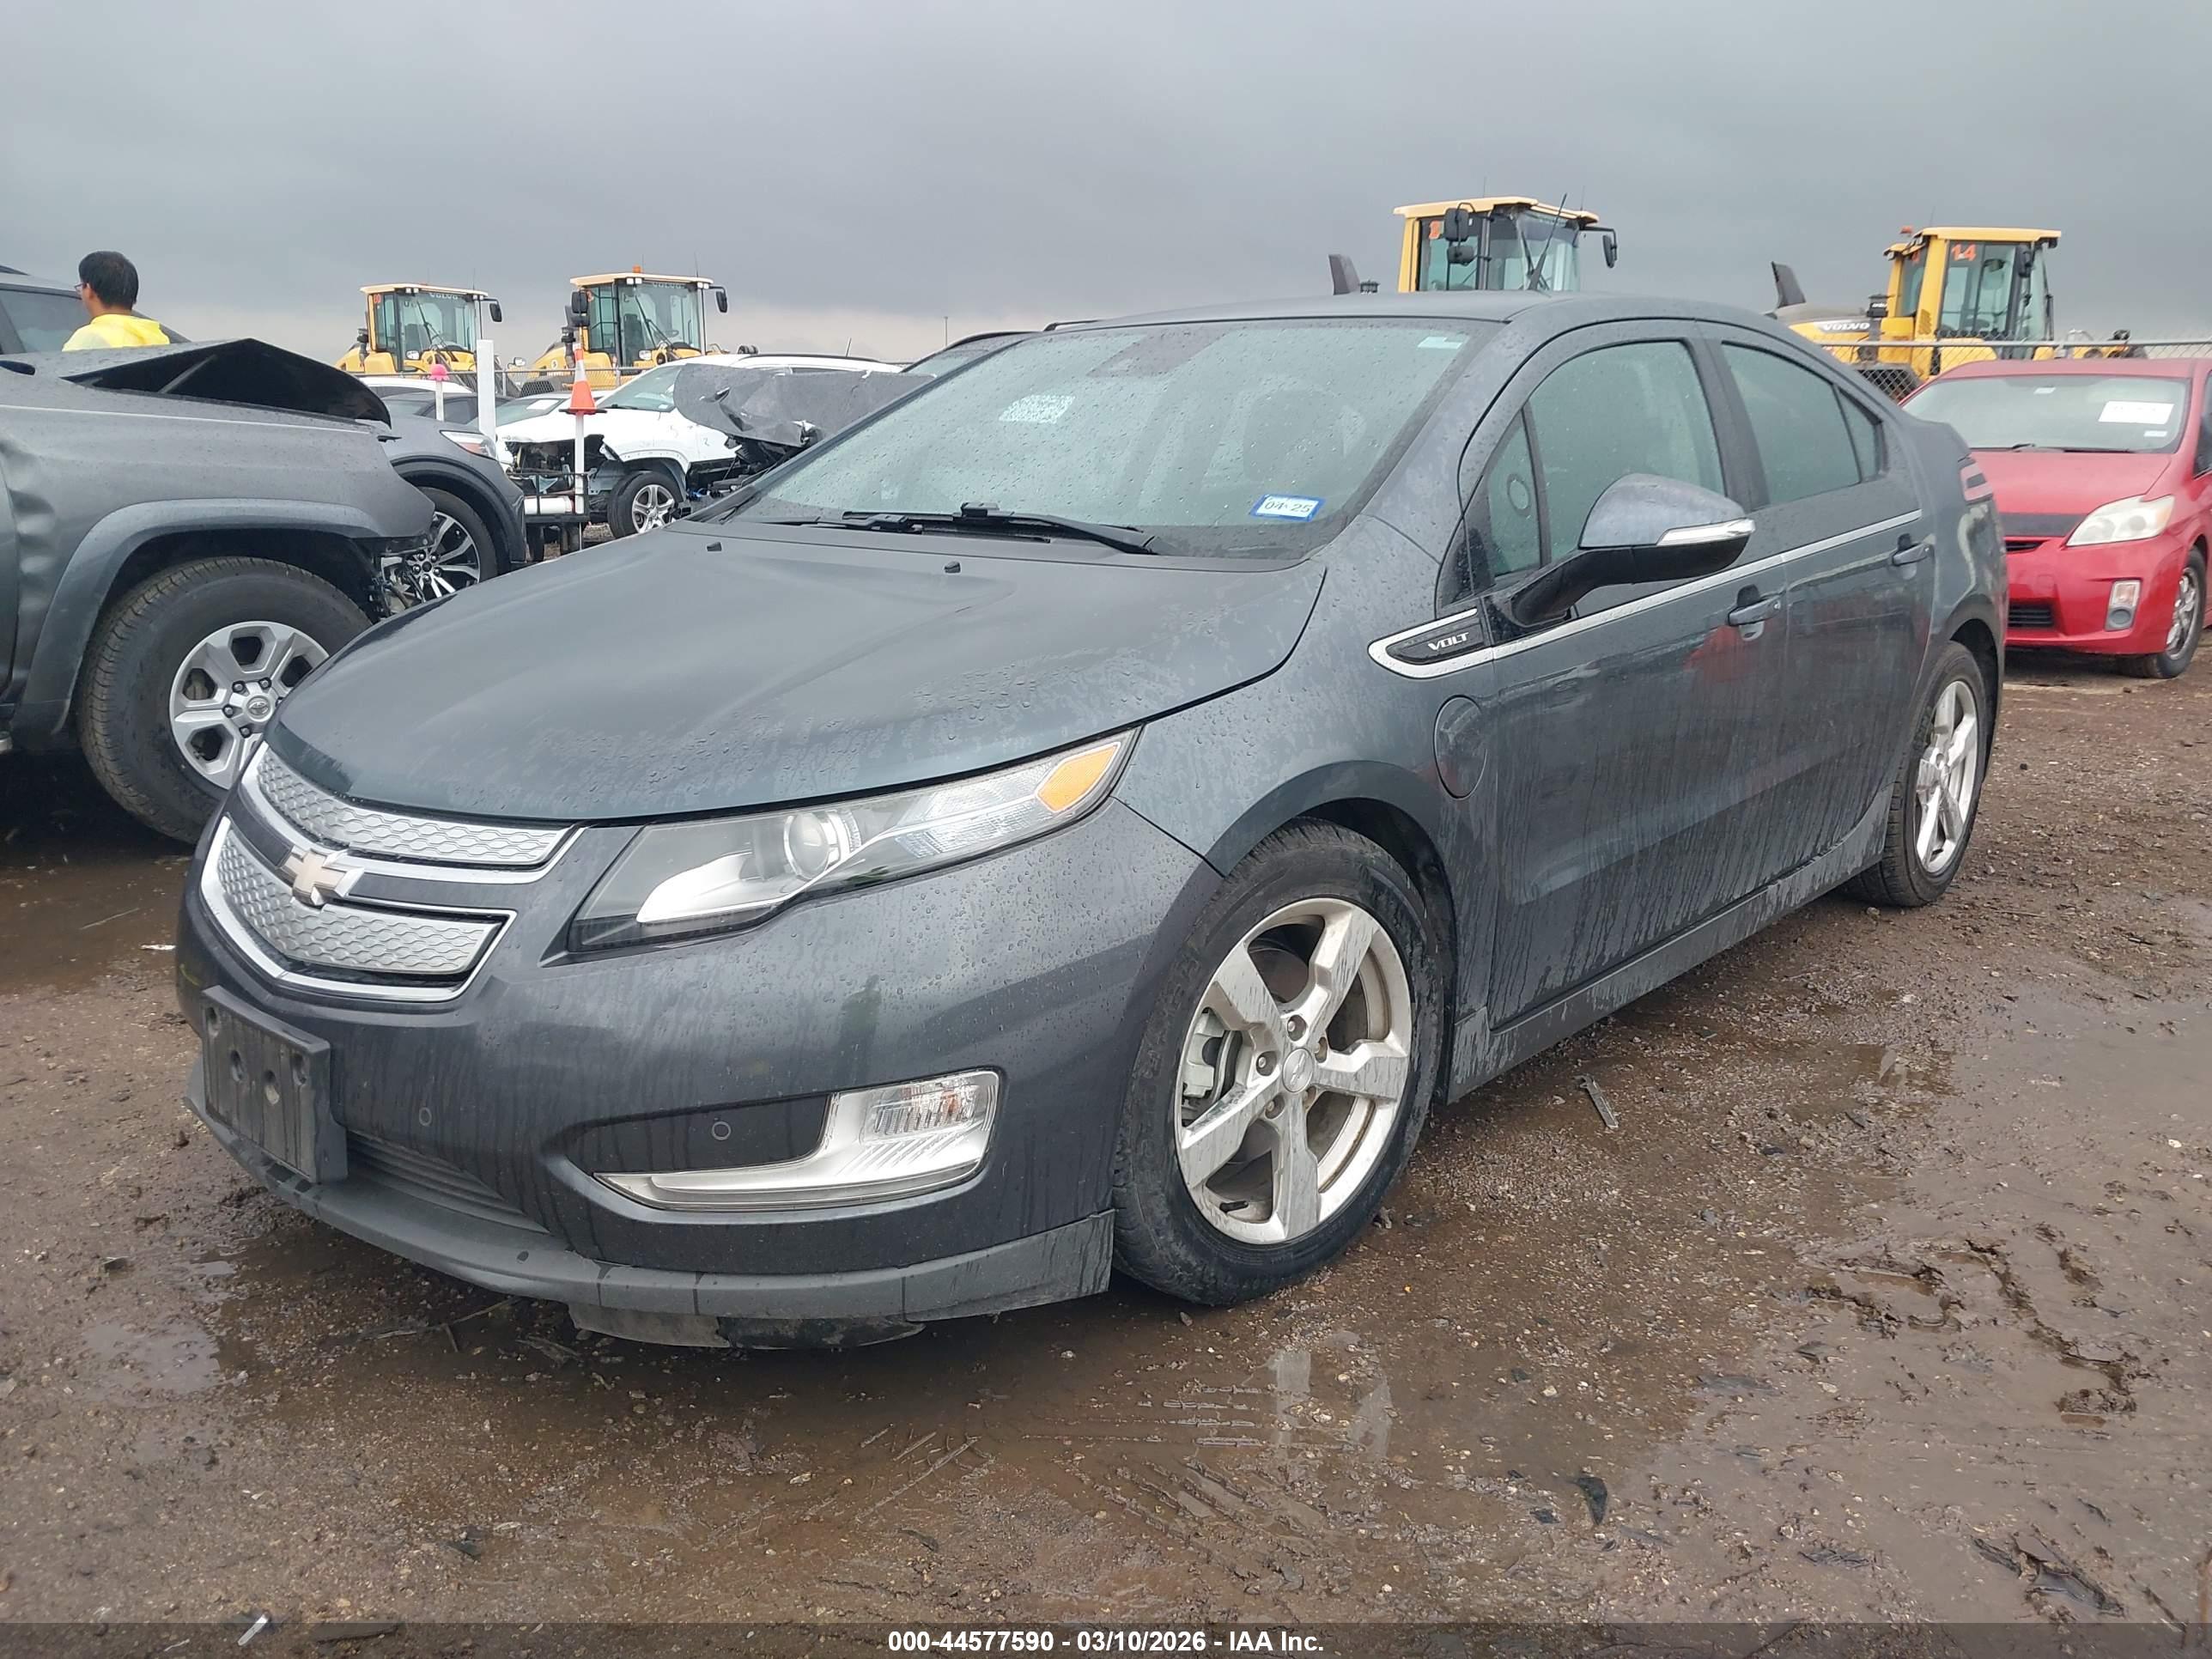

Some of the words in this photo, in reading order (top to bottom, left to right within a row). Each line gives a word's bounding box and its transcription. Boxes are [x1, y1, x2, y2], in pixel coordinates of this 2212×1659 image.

[1952, 243, 1977, 261] 14
[1821, 322, 1870, 331] VOLVO
[1427, 632, 1470, 651] VOLT
